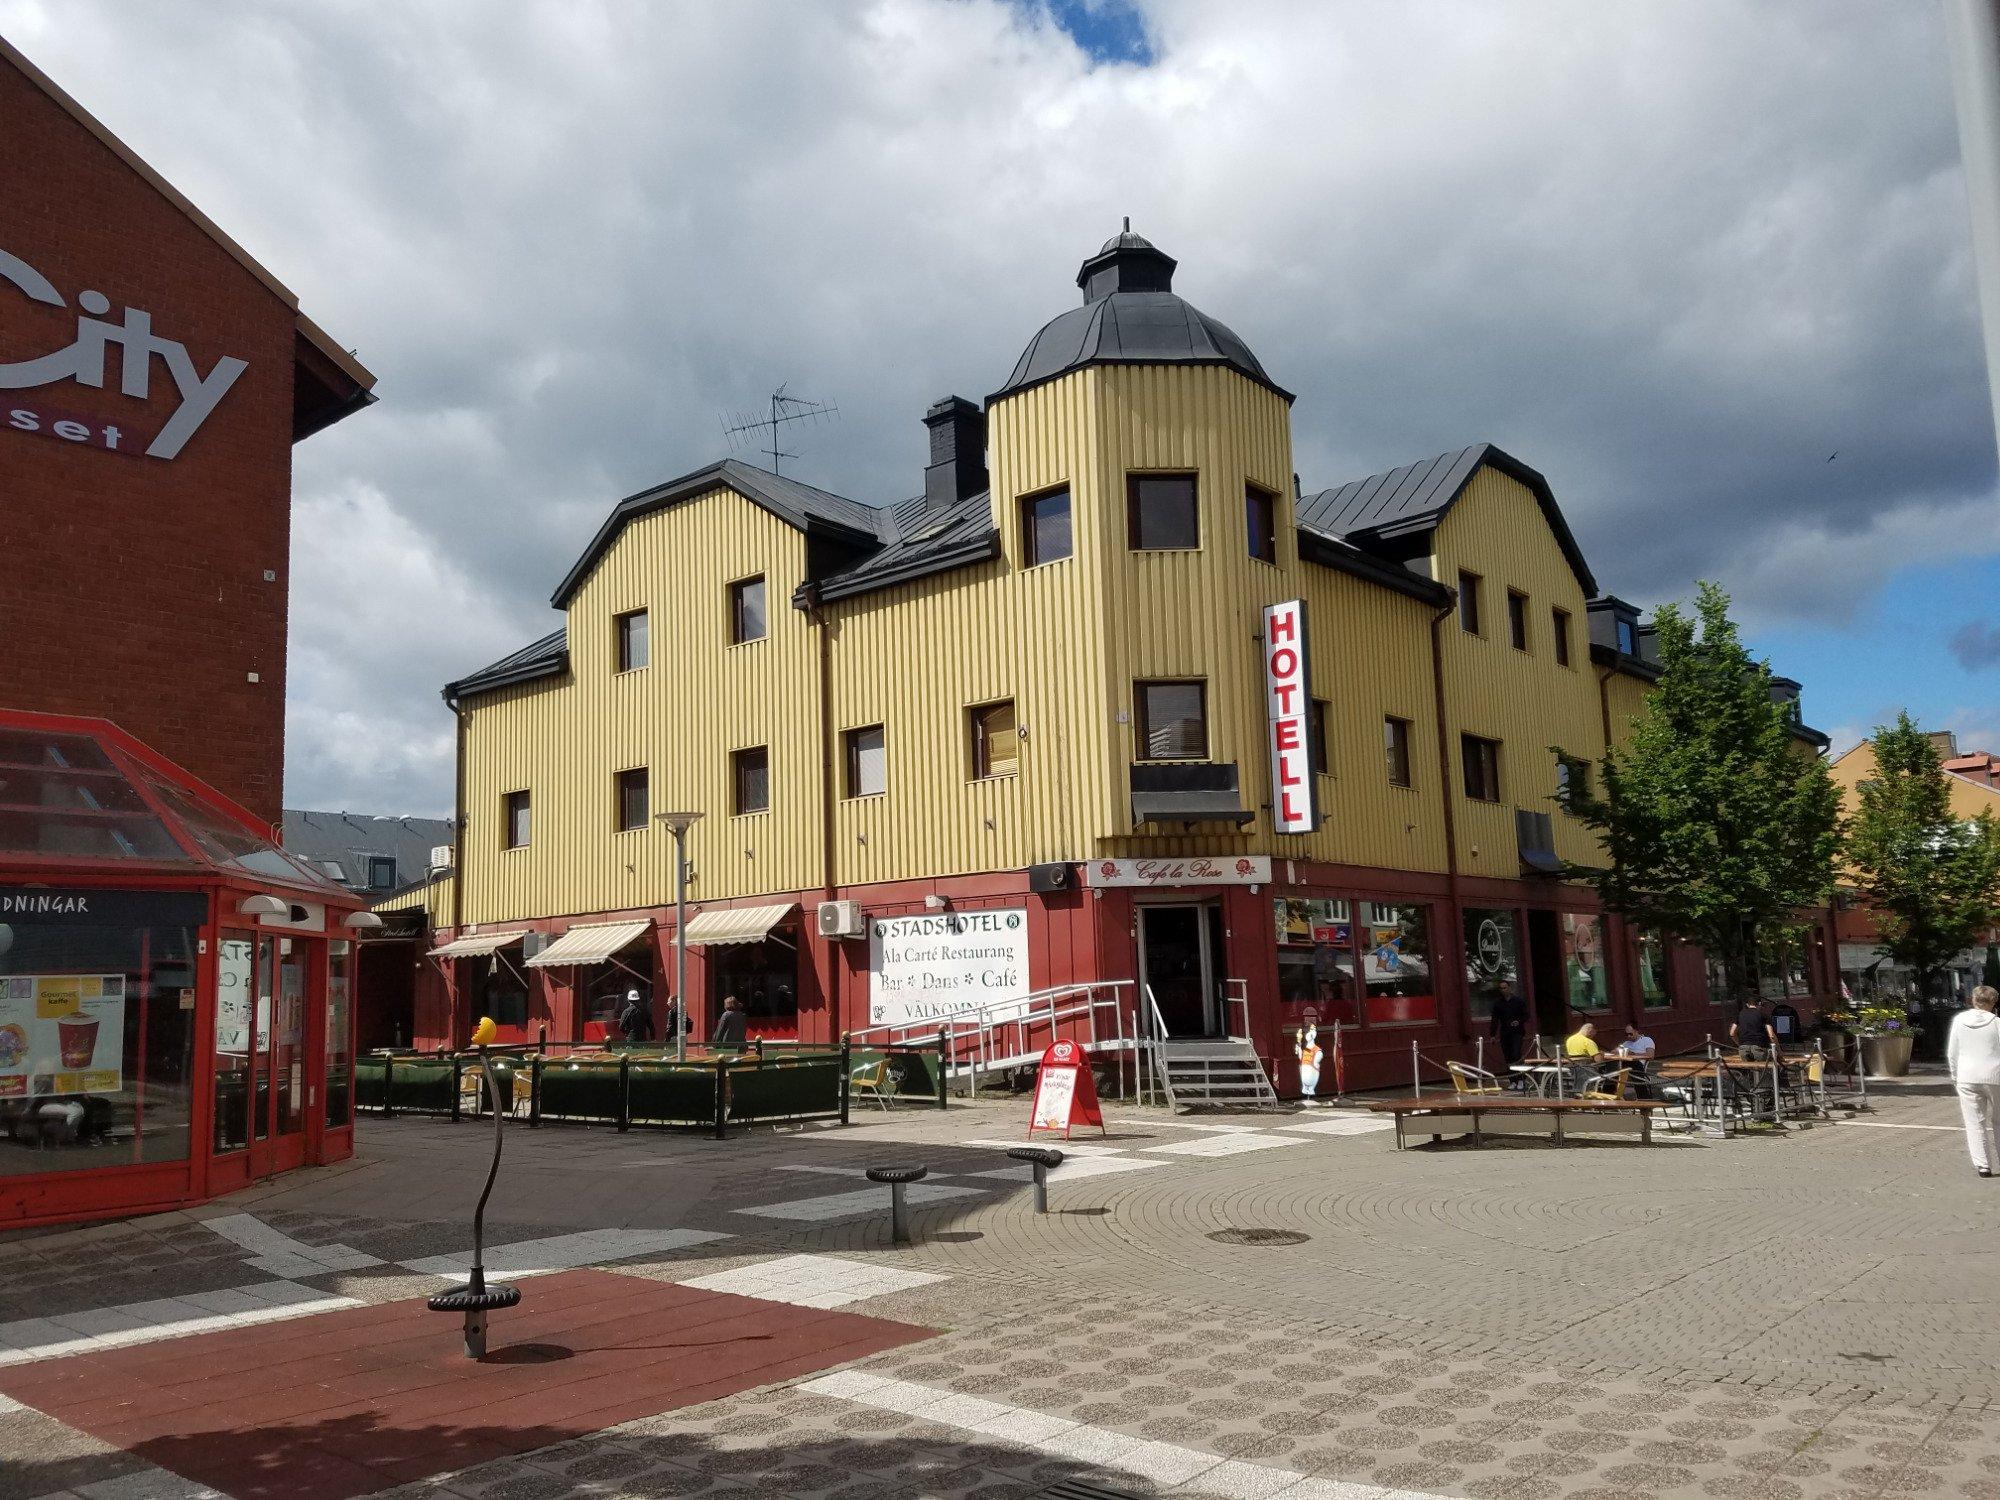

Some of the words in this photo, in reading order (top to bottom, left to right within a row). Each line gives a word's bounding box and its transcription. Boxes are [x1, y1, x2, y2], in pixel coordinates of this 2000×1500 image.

[1269, 611, 1303, 822] HOTELL
[1170, 863, 1184, 878] la
[1188, 859, 1223, 878] Rose
[3, 895, 89, 913] DNINGAR
[891, 914, 1002, 938] STADSHOTEL
[942, 945, 1014, 963] Restaurang
[881, 974, 903, 991] Bar
[922, 972, 959, 990] Dans
[981, 968, 1017, 987] Café
